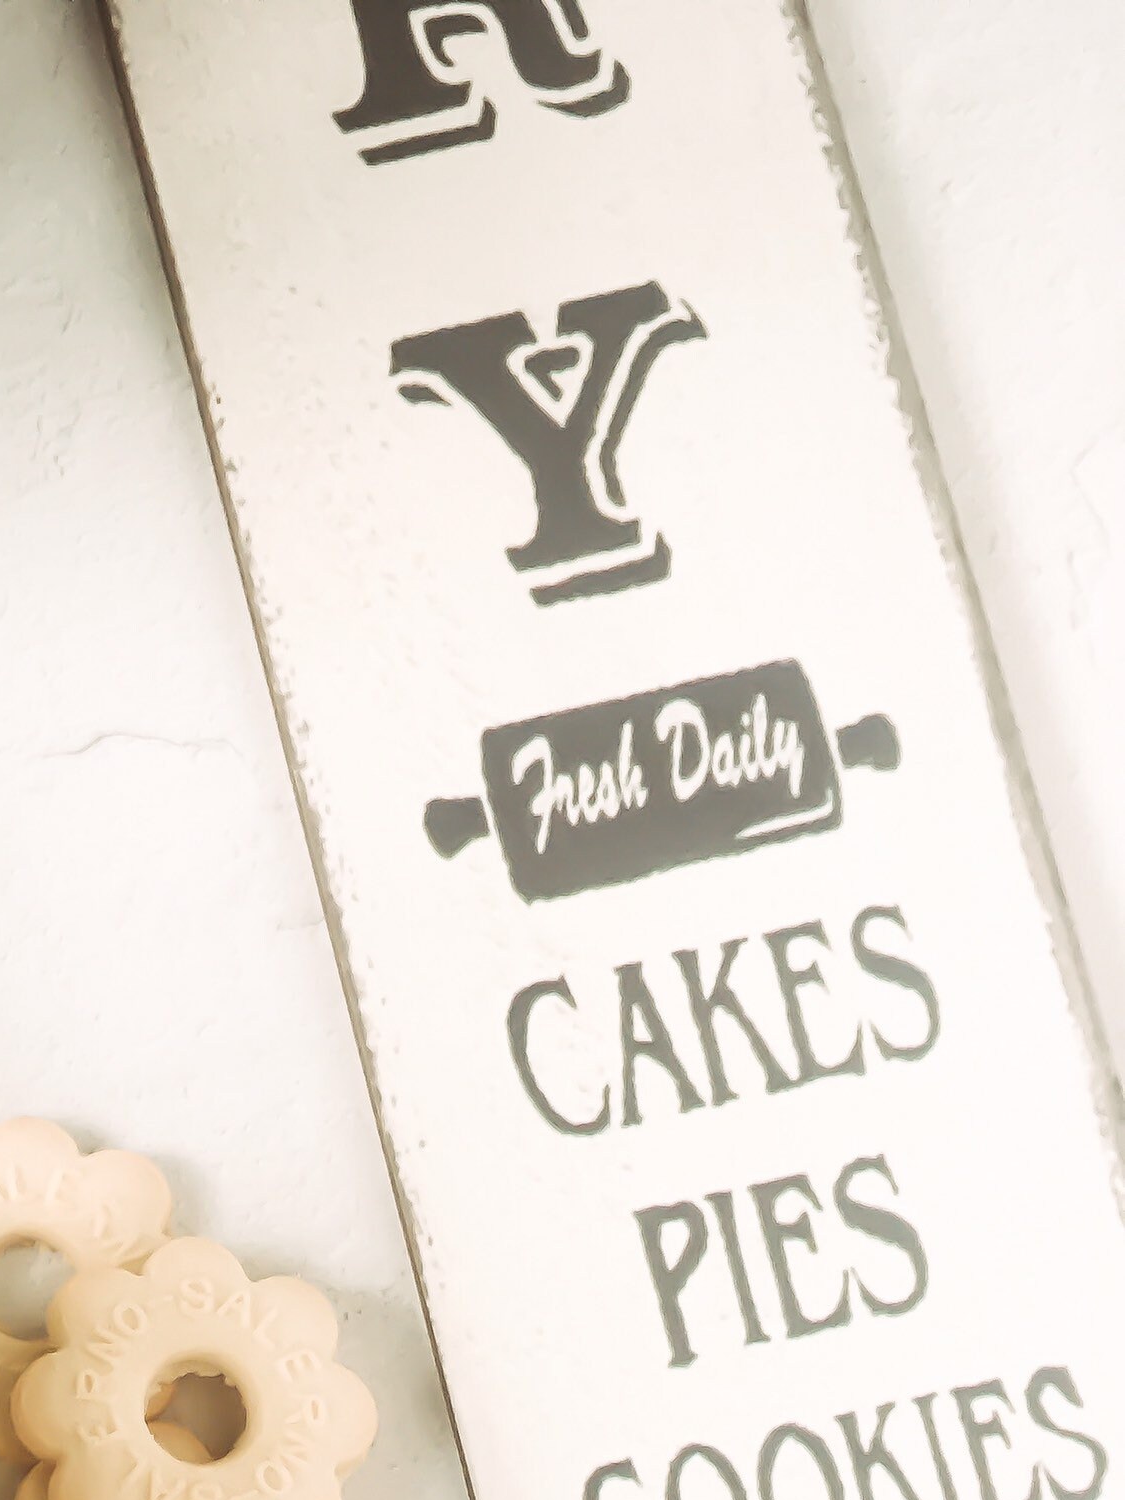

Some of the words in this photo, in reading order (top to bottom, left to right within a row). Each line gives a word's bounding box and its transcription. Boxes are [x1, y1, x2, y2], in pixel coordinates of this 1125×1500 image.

[513, 728, 647, 852] Fresh
[656, 695, 805, 797] Daily
[506, 905, 941, 1137] CAKES
[633, 1154, 929, 1368] PIES
